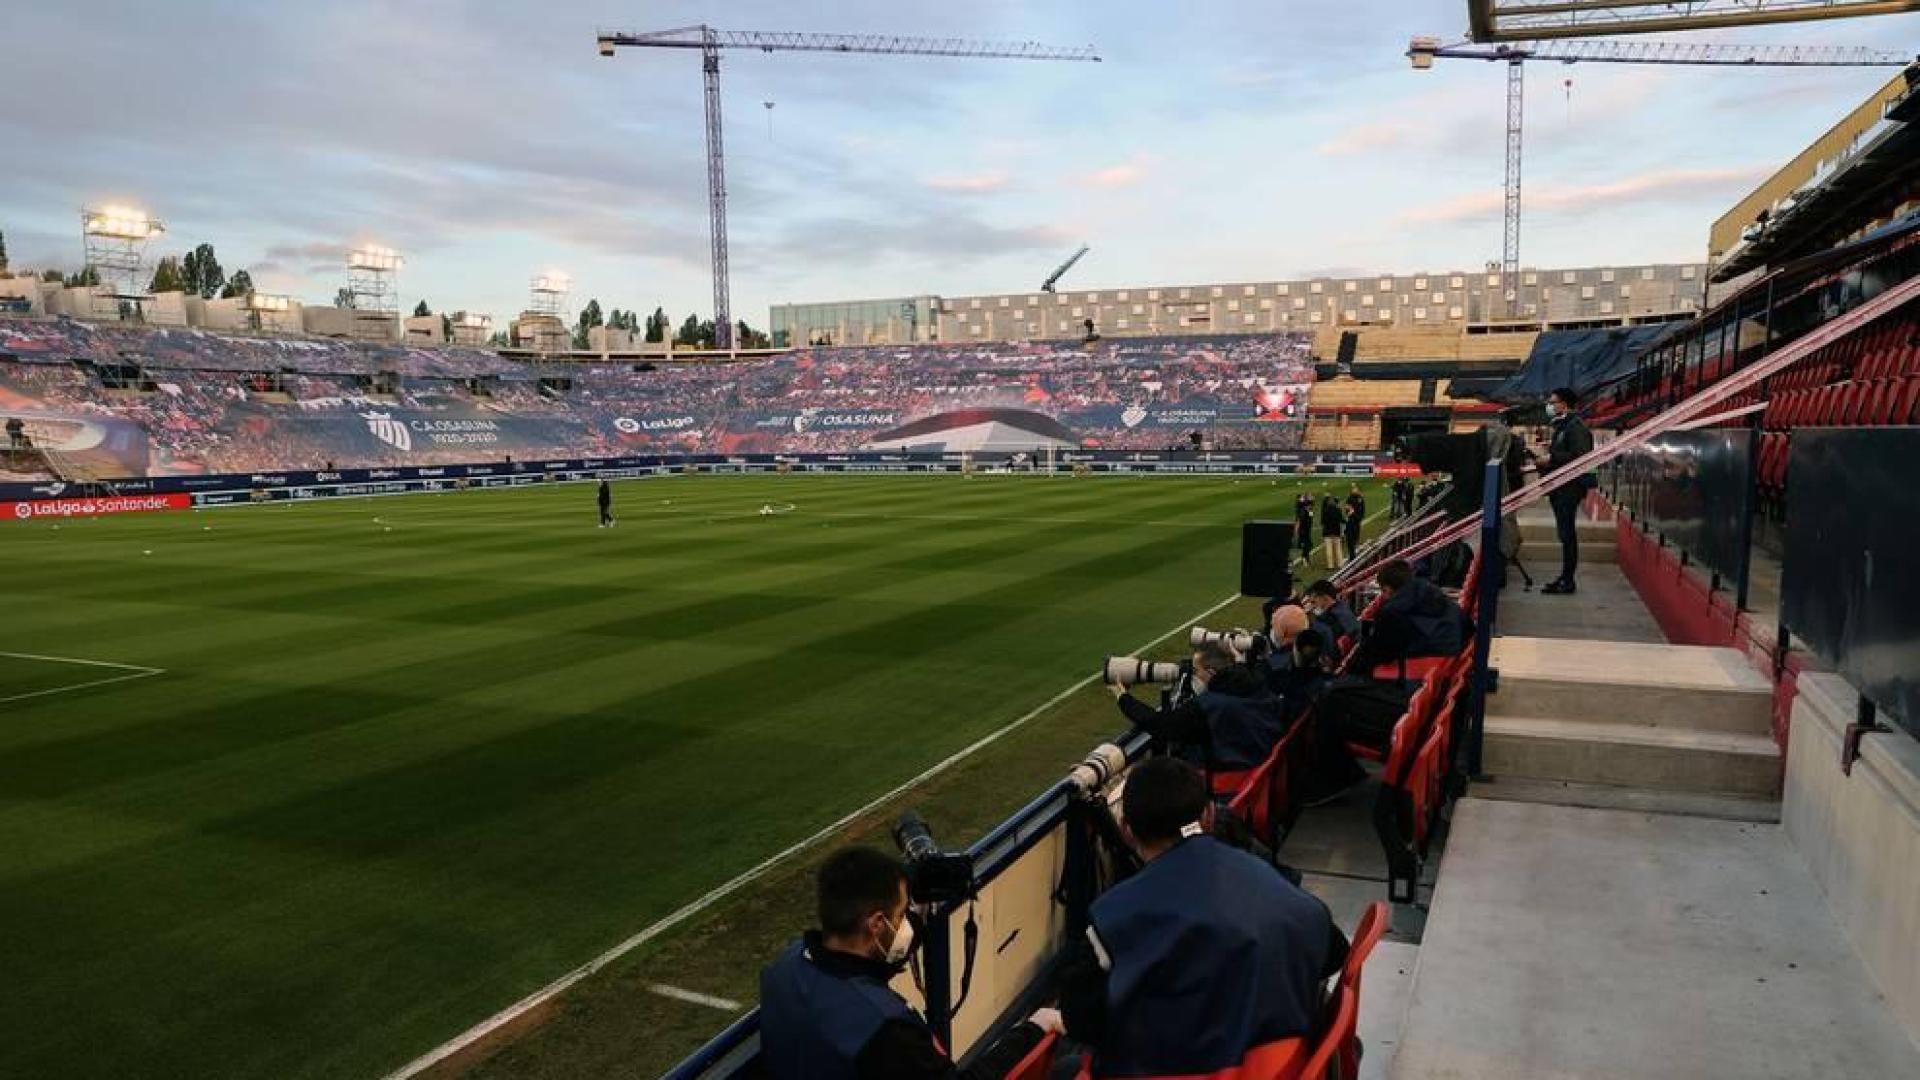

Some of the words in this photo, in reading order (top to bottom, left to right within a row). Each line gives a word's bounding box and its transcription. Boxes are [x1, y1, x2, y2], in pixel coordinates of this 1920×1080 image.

[642, 416, 694, 429] LaLiga
[823, 414, 893, 425] OSASUNA
[34, 498, 81, 515] LaLiga
[96, 494, 169, 513] Santander
